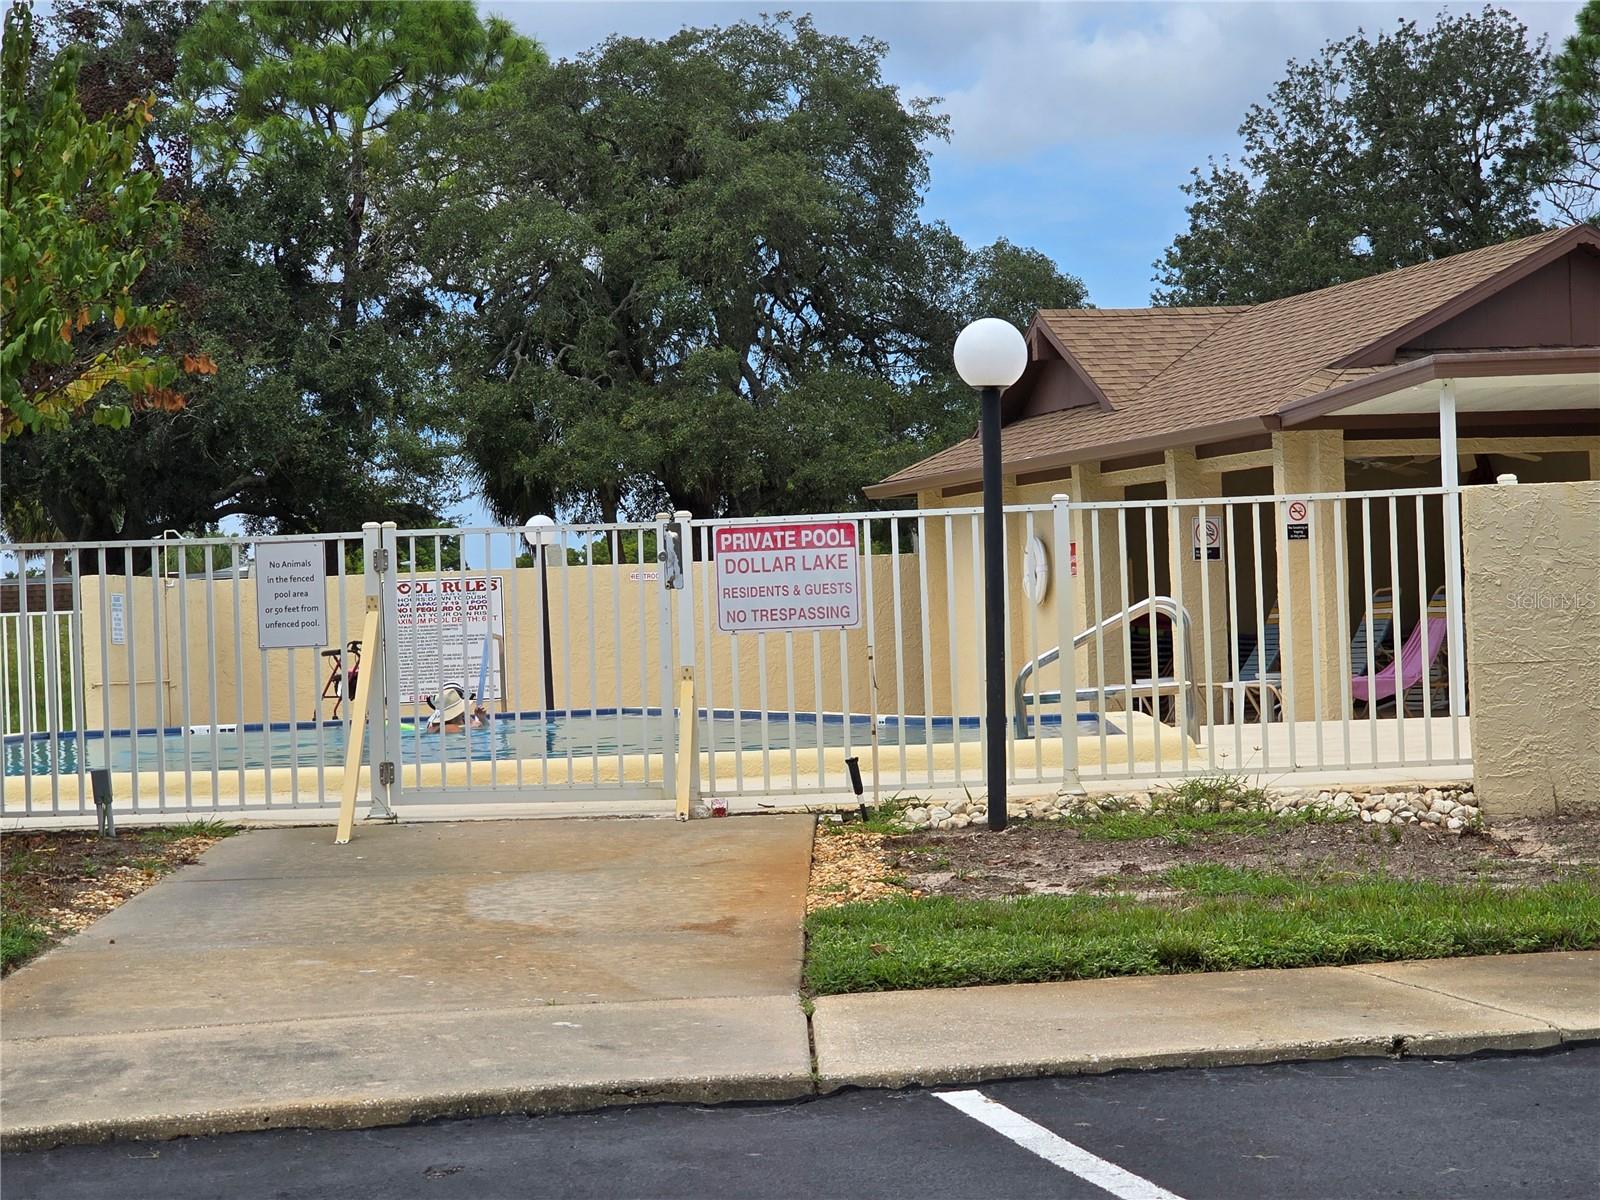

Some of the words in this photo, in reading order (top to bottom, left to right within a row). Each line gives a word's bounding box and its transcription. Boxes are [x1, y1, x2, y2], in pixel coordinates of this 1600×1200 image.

[720, 530, 797, 550] PRIVATE
[801, 528, 851, 547] POOL
[269, 561, 281, 569] No
[281, 560, 312, 568] Animals
[725, 555, 796, 574] DOLLAR
[802, 553, 849, 571] LAKE
[275, 575, 289, 583] the
[289, 574, 315, 582] fenced
[274, 589, 291, 600] pool
[723, 585, 789, 599] RESIDENTS
[793, 584, 801, 596] &
[804, 582, 853, 596] GUESTS
[274, 607, 283, 615] 50
[284, 605, 300, 613] feet
[301, 604, 319, 612] from
[726, 609, 747, 623] NO
[751, 605, 850, 622] TRESPASSING
[265, 620, 300, 629] unfenced
[301, 619, 320, 629] pool.
